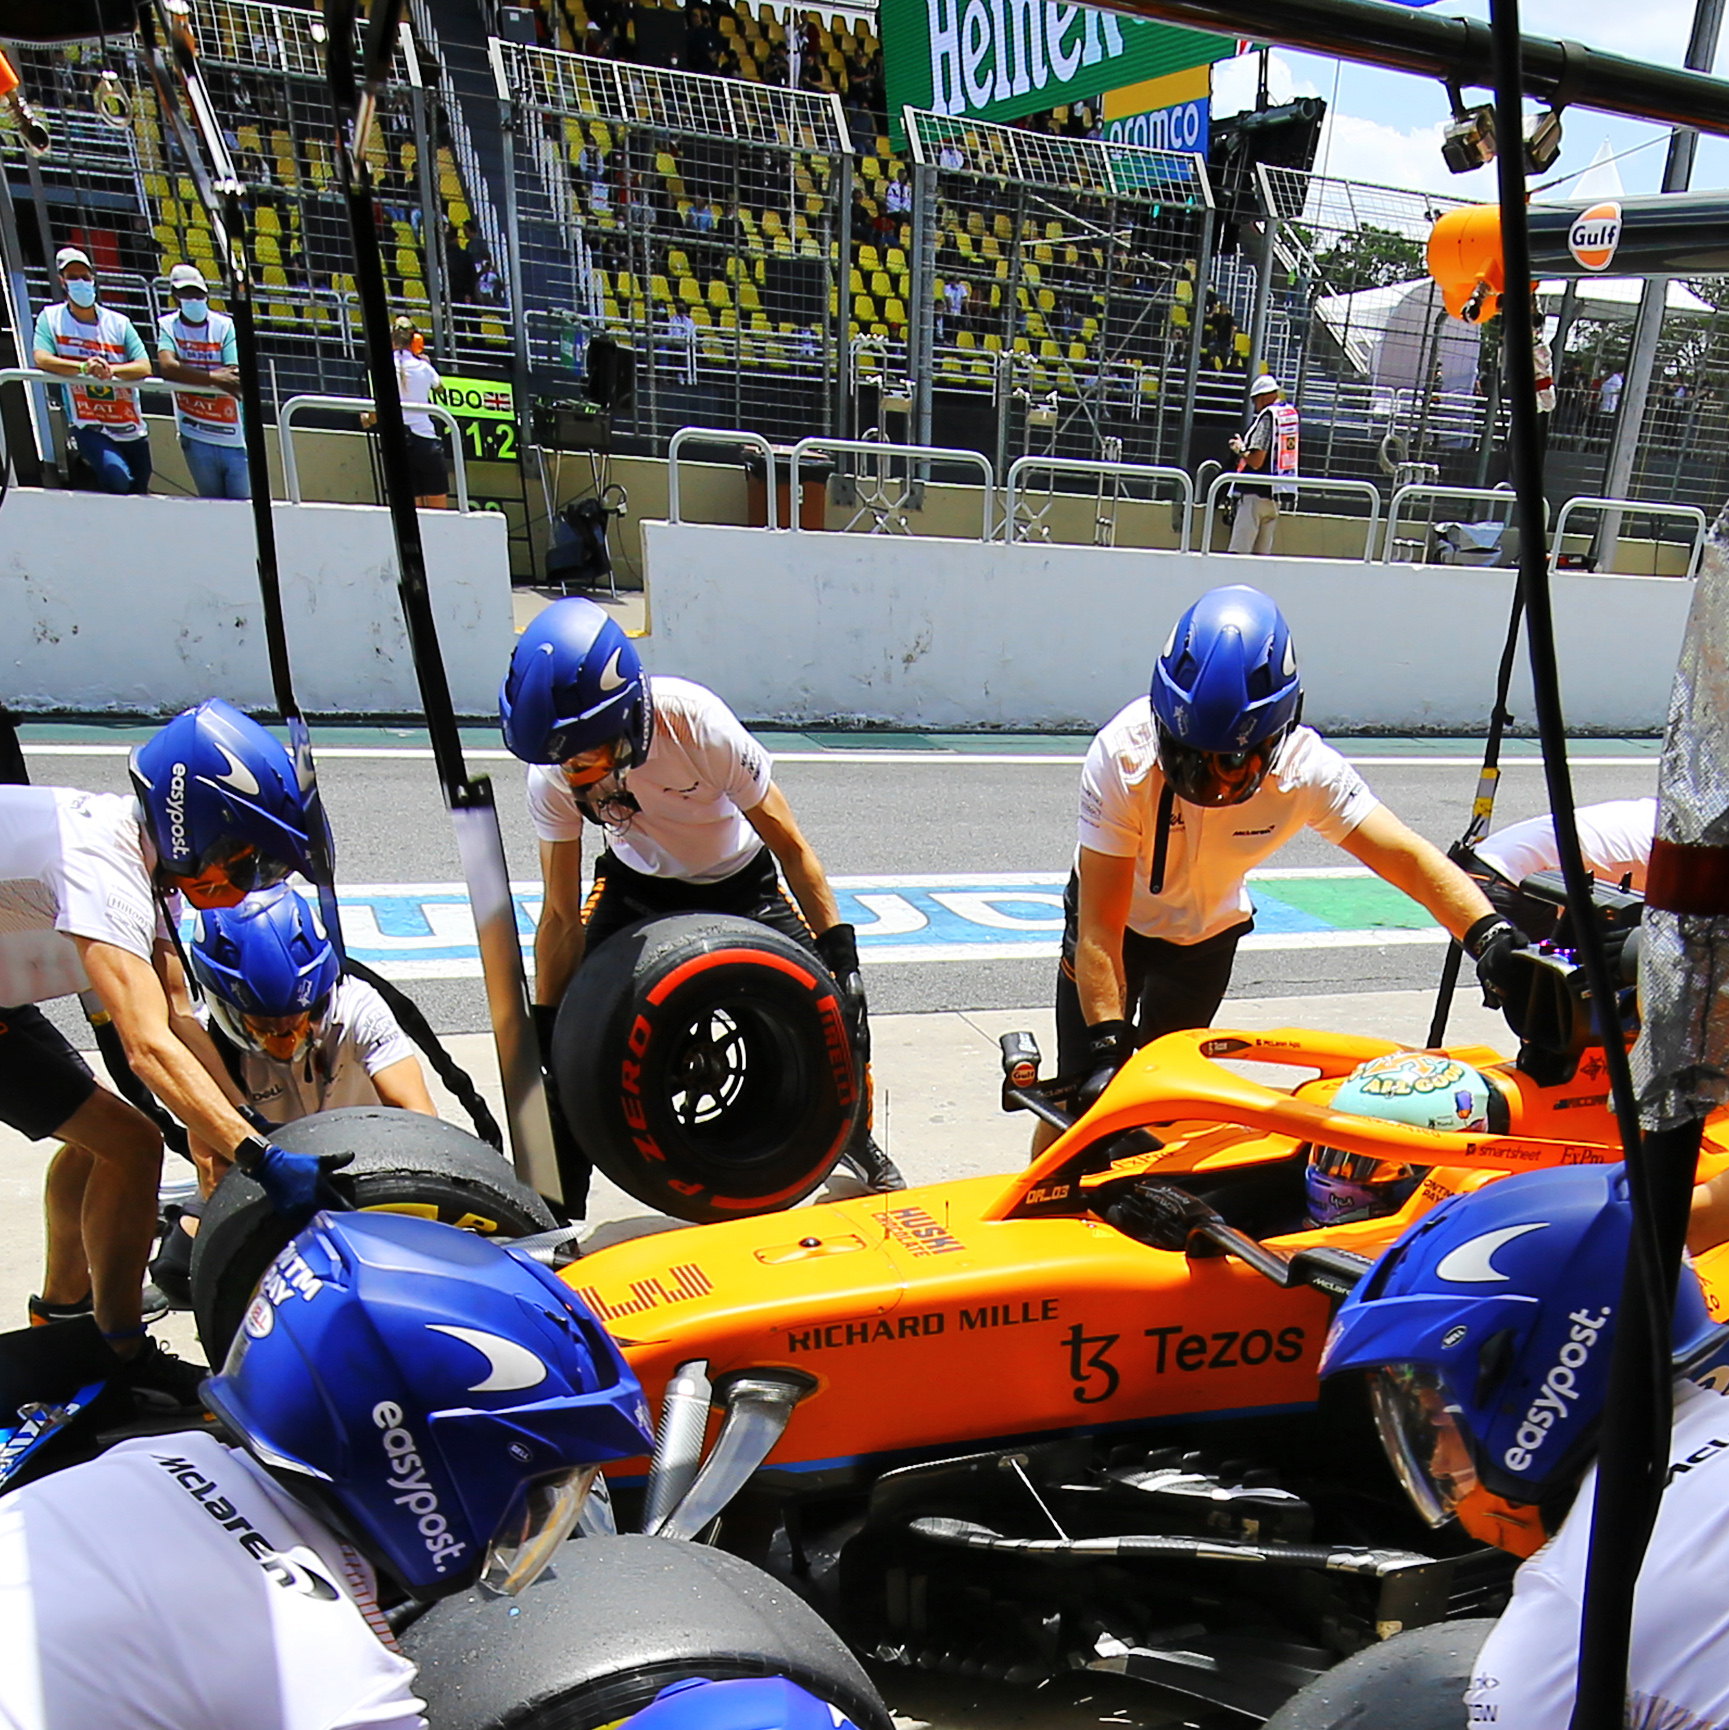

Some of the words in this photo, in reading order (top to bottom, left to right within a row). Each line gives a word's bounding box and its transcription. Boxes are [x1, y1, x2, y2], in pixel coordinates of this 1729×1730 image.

[1572, 225, 1617, 246] Gulf
[165, 761, 191, 860] easypost.
[621, 1014, 666, 1162] ZERO
[1012, 1070, 1035, 1080] Gulf
[1478, 1146, 1542, 1162] smartsheet
[889, 1206, 967, 1255] HUSKI
[787, 1311, 945, 1354] RICHARD
[958, 1298, 1060, 1332] MILLE
[1144, 1324, 1305, 1375] Tezos
[1503, 1304, 1612, 1473] easypost.
[509, 1444, 531, 1461] BELL
[373, 1400, 467, 1574] easypost.
[149, 1453, 297, 1589] McLaren
